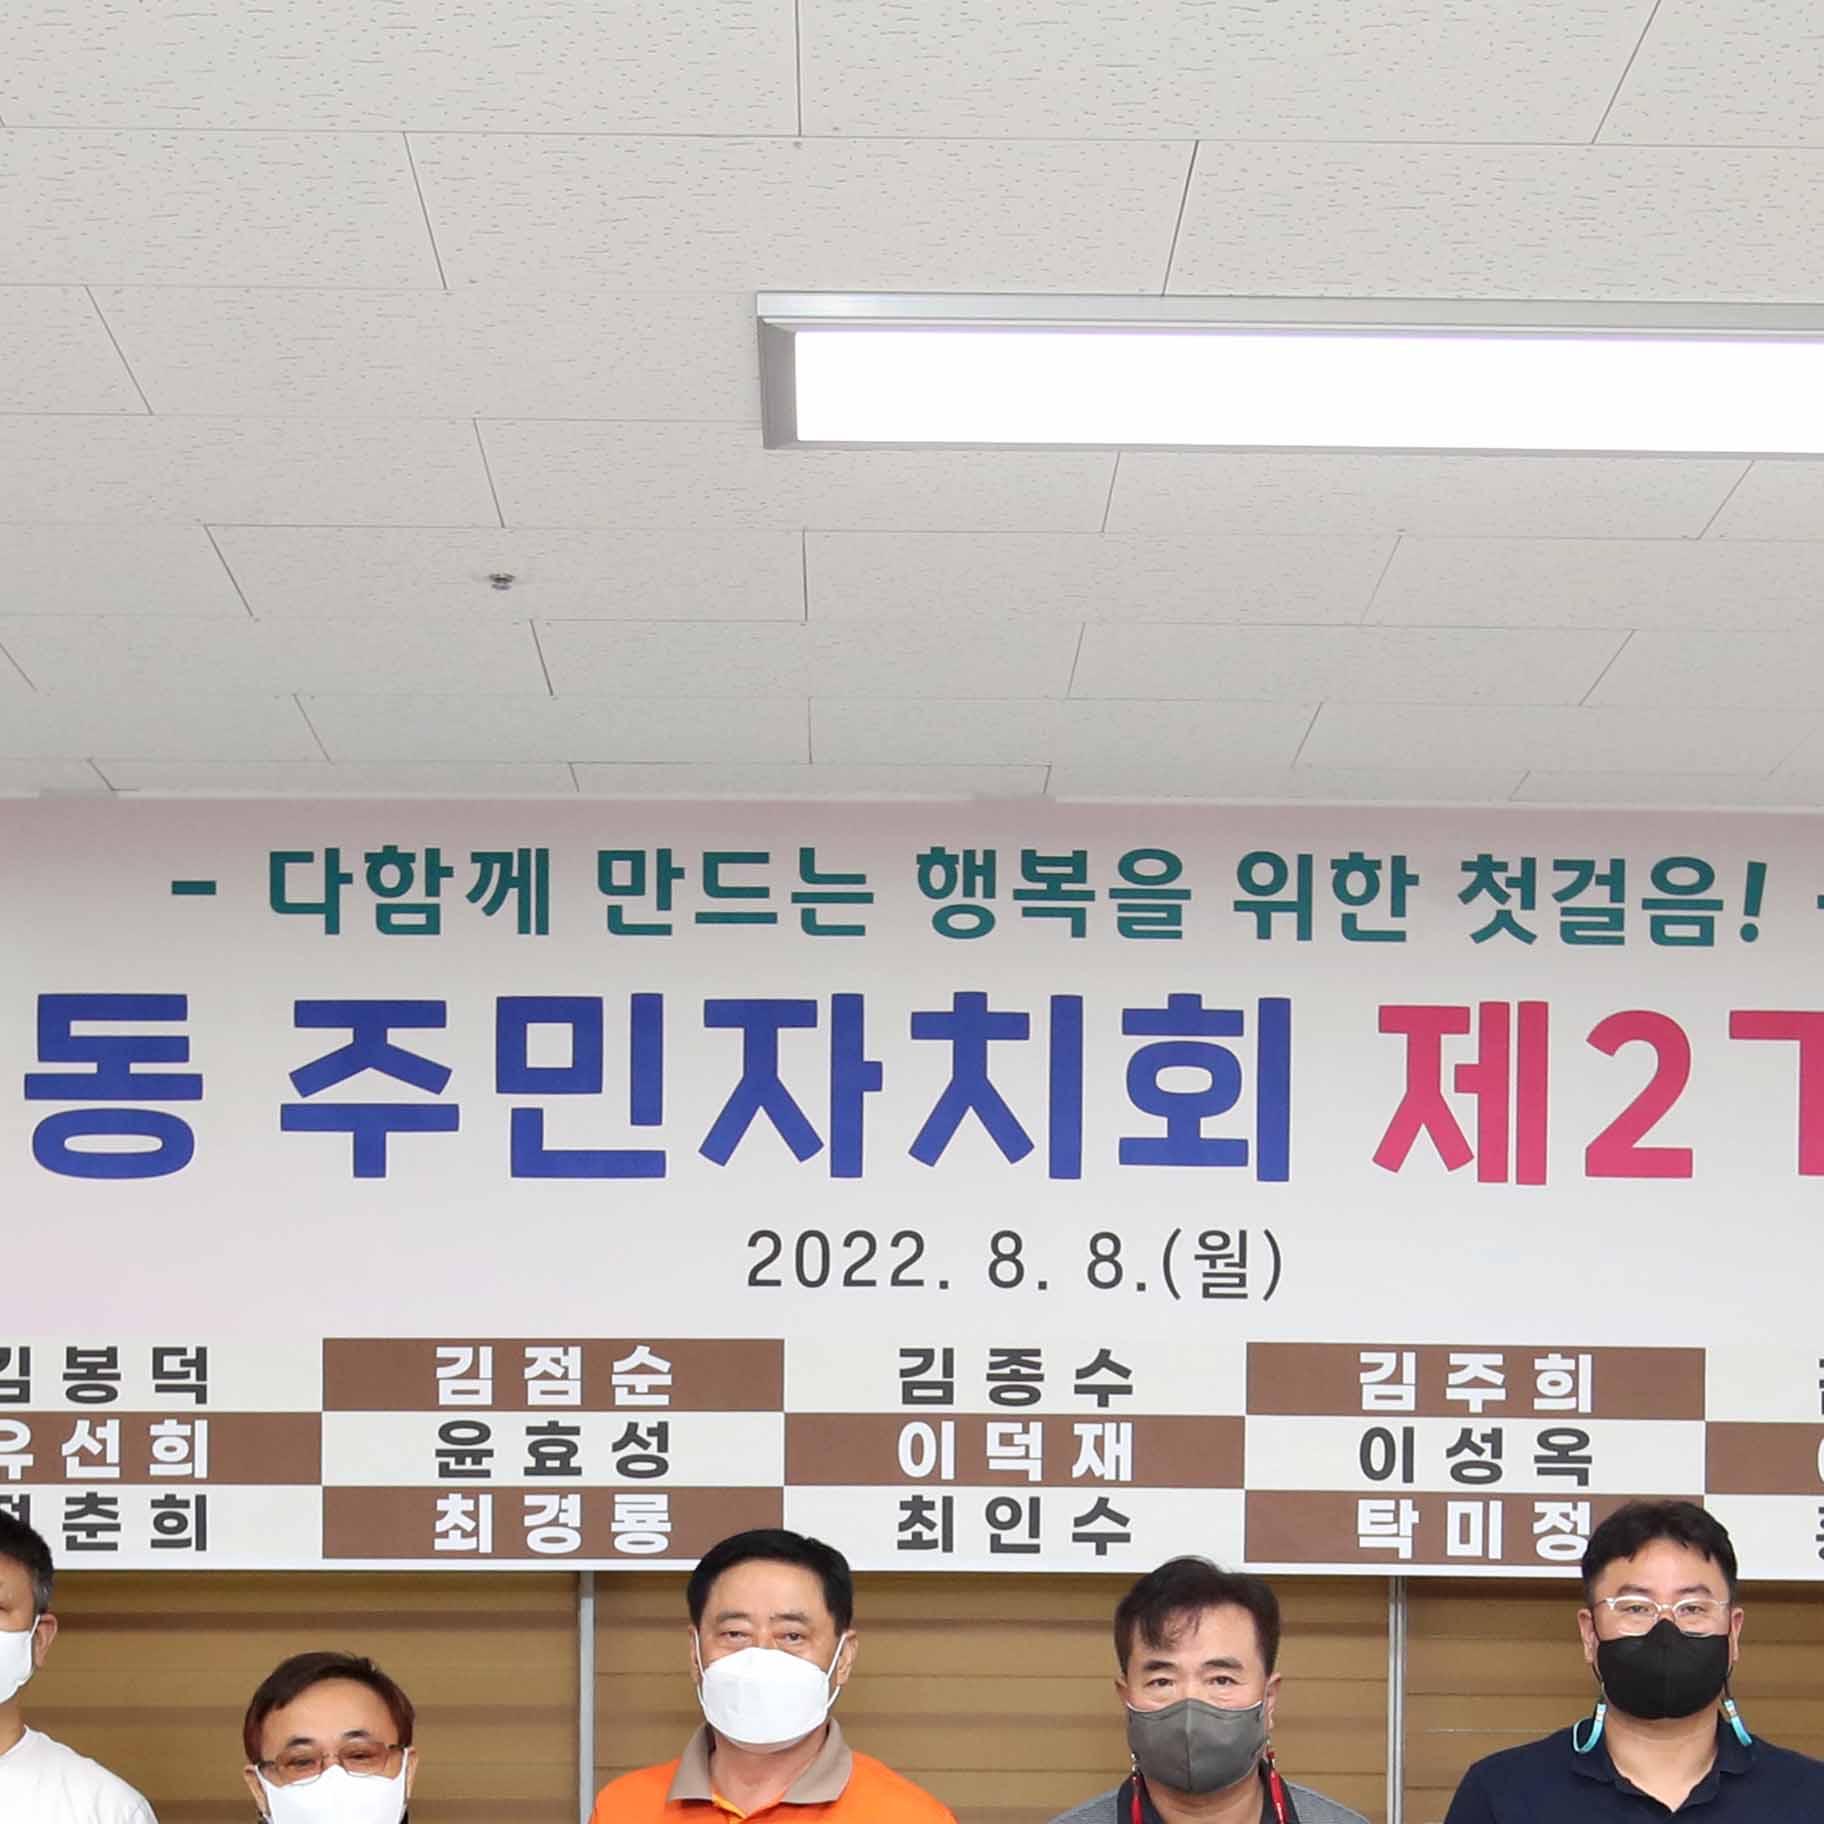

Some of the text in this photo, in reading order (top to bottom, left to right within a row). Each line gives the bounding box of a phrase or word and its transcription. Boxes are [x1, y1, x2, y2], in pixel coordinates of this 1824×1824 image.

[270, 845, 549, 935] 다함께
[598, 848, 874, 936] 만드는
[917, 847, 1191, 939] 행복을
[1234, 851, 1419, 942] 위한
[1458, 854, 1766, 946] 첫걸음!
[280, 992, 1291, 1182] 주민자치회
[748, 1230, 948, 1289] 2022.
[989, 1230, 1047, 1290] 8.
[437, 1346, 672, 1405] 김점순
[899, 1348, 1133, 1408] 김종수
[1360, 1352, 1591, 1413] 김주희
[435, 1420, 669, 1479] 윤효성
[899, 1421, 1132, 1481] 이덕재
[1360, 1427, 1592, 1486] 이성옥
[435, 1494, 671, 1553] 최경룡
[897, 1495, 1131, 1555] 최인수
[1358, 1500, 1591, 1560] 탁미정
